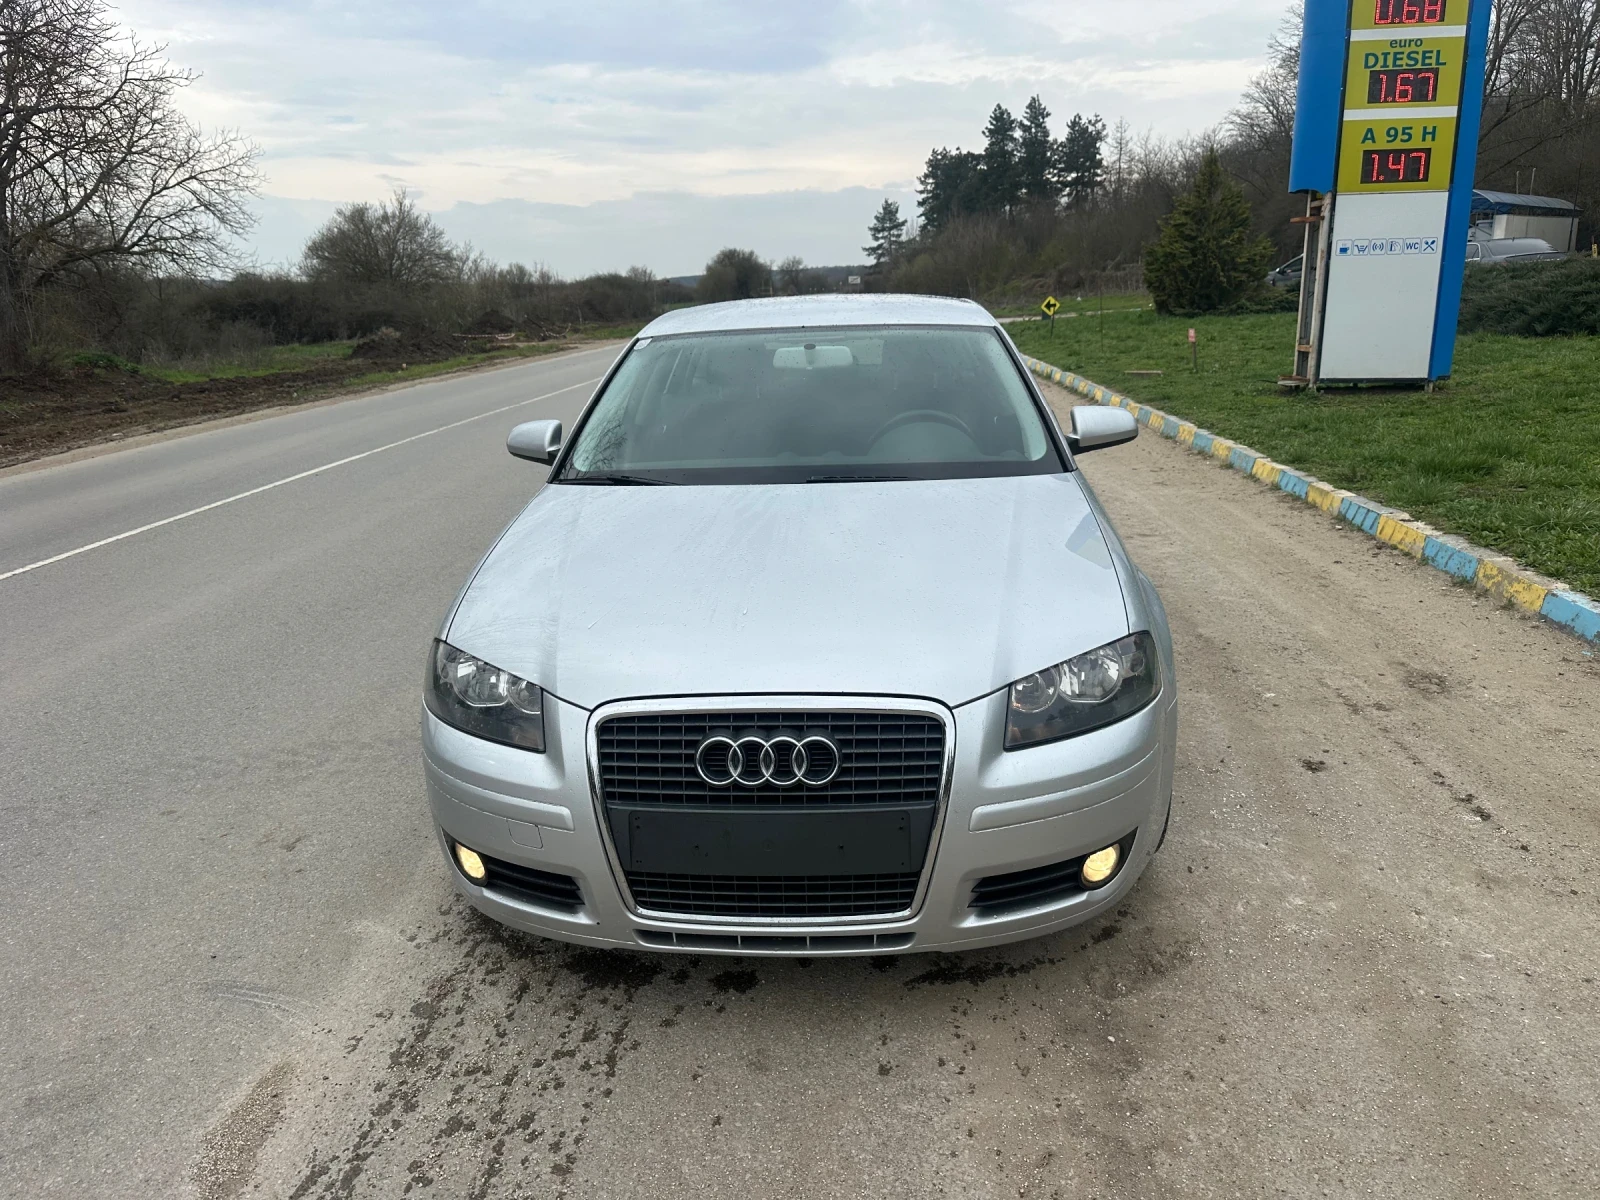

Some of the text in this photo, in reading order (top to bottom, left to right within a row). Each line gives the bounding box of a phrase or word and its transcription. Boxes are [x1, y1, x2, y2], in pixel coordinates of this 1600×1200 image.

[1374, 0, 1443, 24] 0.68
[1389, 38, 1423, 49] euro
[1364, 50, 1447, 69] DIESEL
[1379, 72, 1435, 103] 1.67
[1361, 125, 1437, 144] A 95 H
[1371, 152, 1426, 181] 1.47
[1405, 241, 1419, 250] WC
